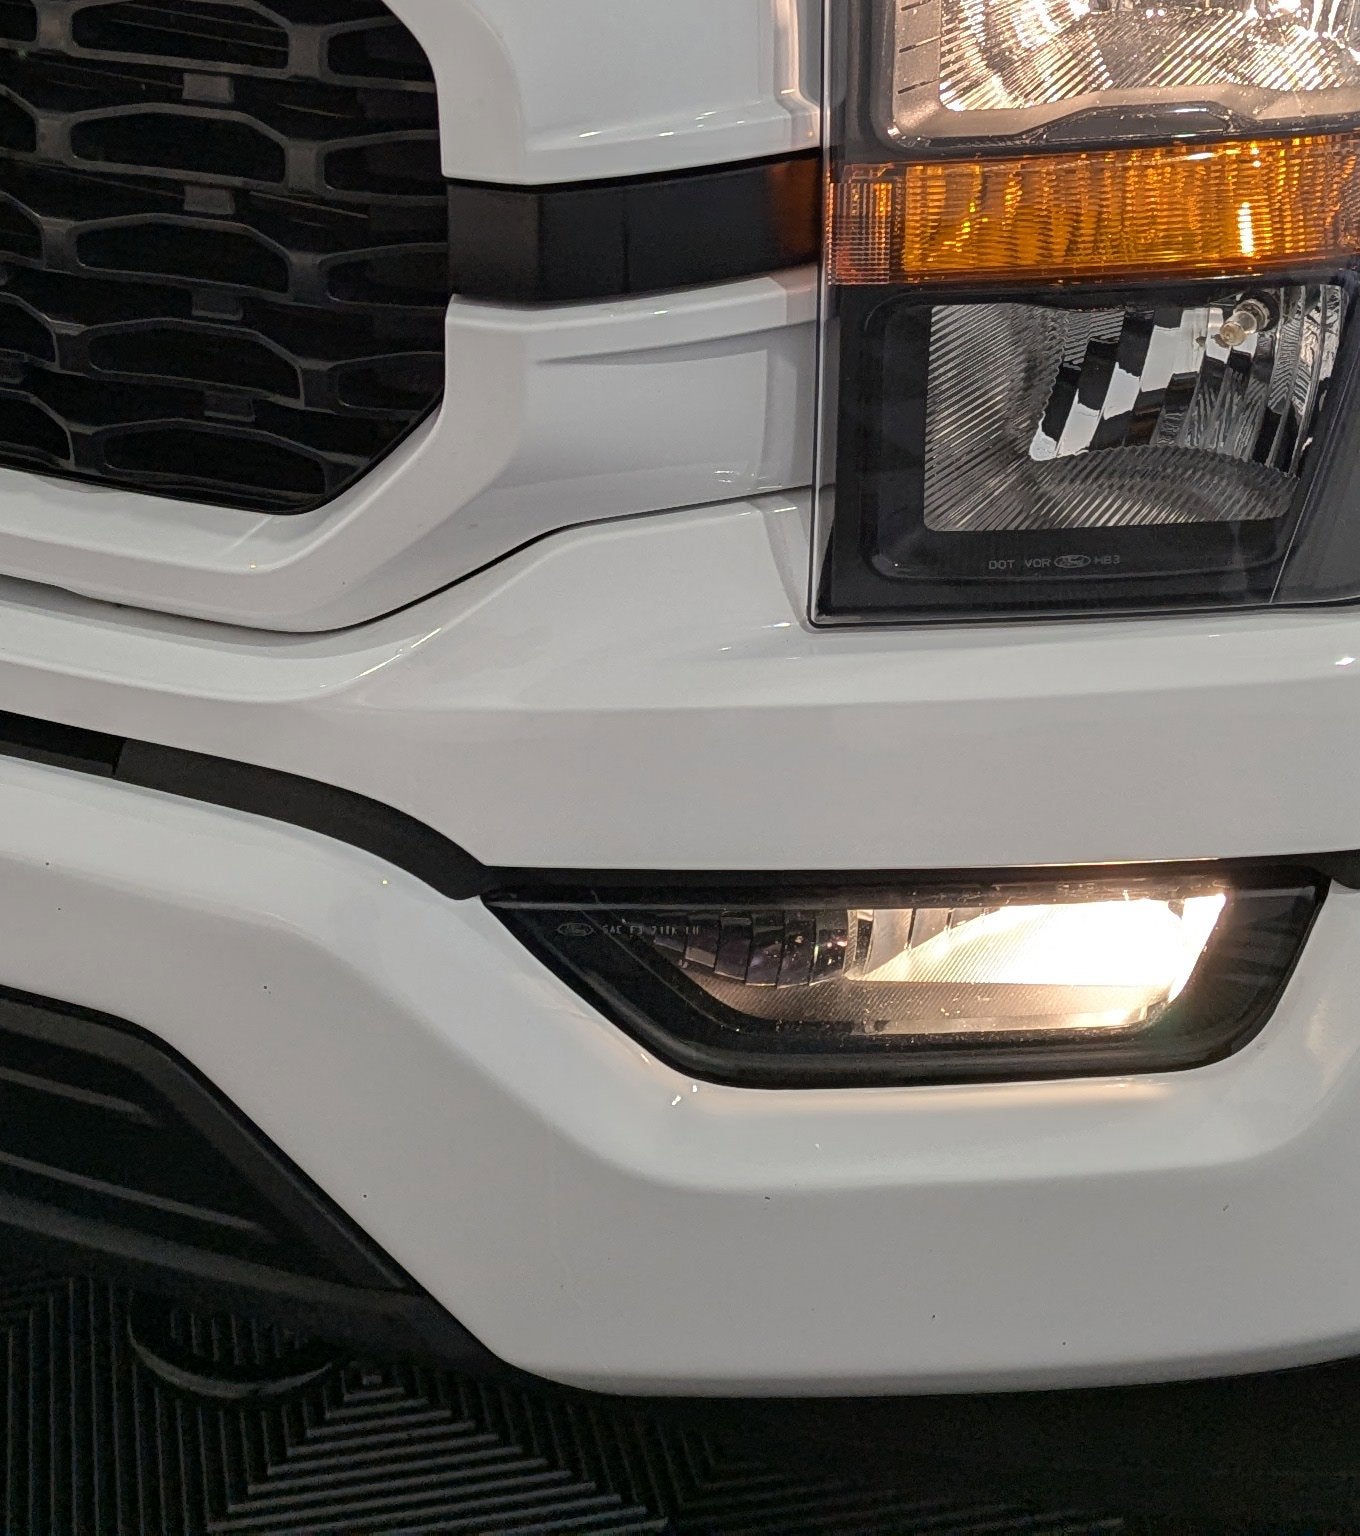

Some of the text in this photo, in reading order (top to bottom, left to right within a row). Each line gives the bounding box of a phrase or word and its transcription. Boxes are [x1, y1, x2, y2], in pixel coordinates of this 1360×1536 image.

[988, 559, 1015, 570] DOT
[1024, 558, 1051, 568] VOR
[1093, 554, 1121, 565] HB3
